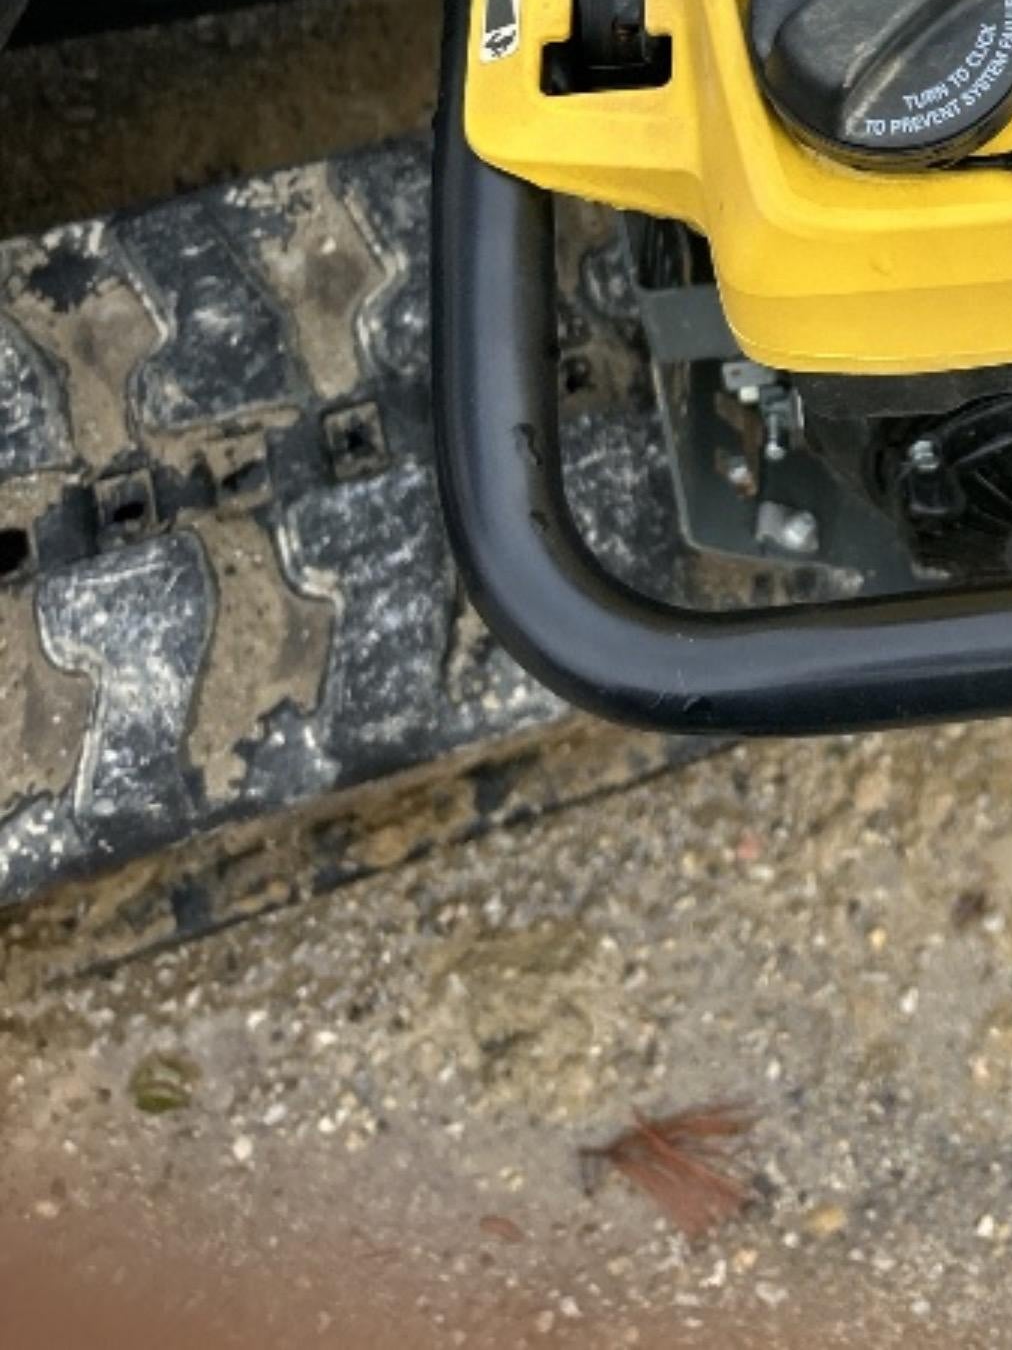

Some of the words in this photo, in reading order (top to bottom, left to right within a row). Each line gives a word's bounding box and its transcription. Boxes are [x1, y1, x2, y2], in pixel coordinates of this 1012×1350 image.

[865, 119, 886, 136] TO
[890, 98, 962, 136] PREVENT
[960, 50, 1009, 106] SYSTEM
[902, 82, 950, 111] TURN
[947, 65, 970, 88] TO
[965, 23, 997, 68] CLICK
